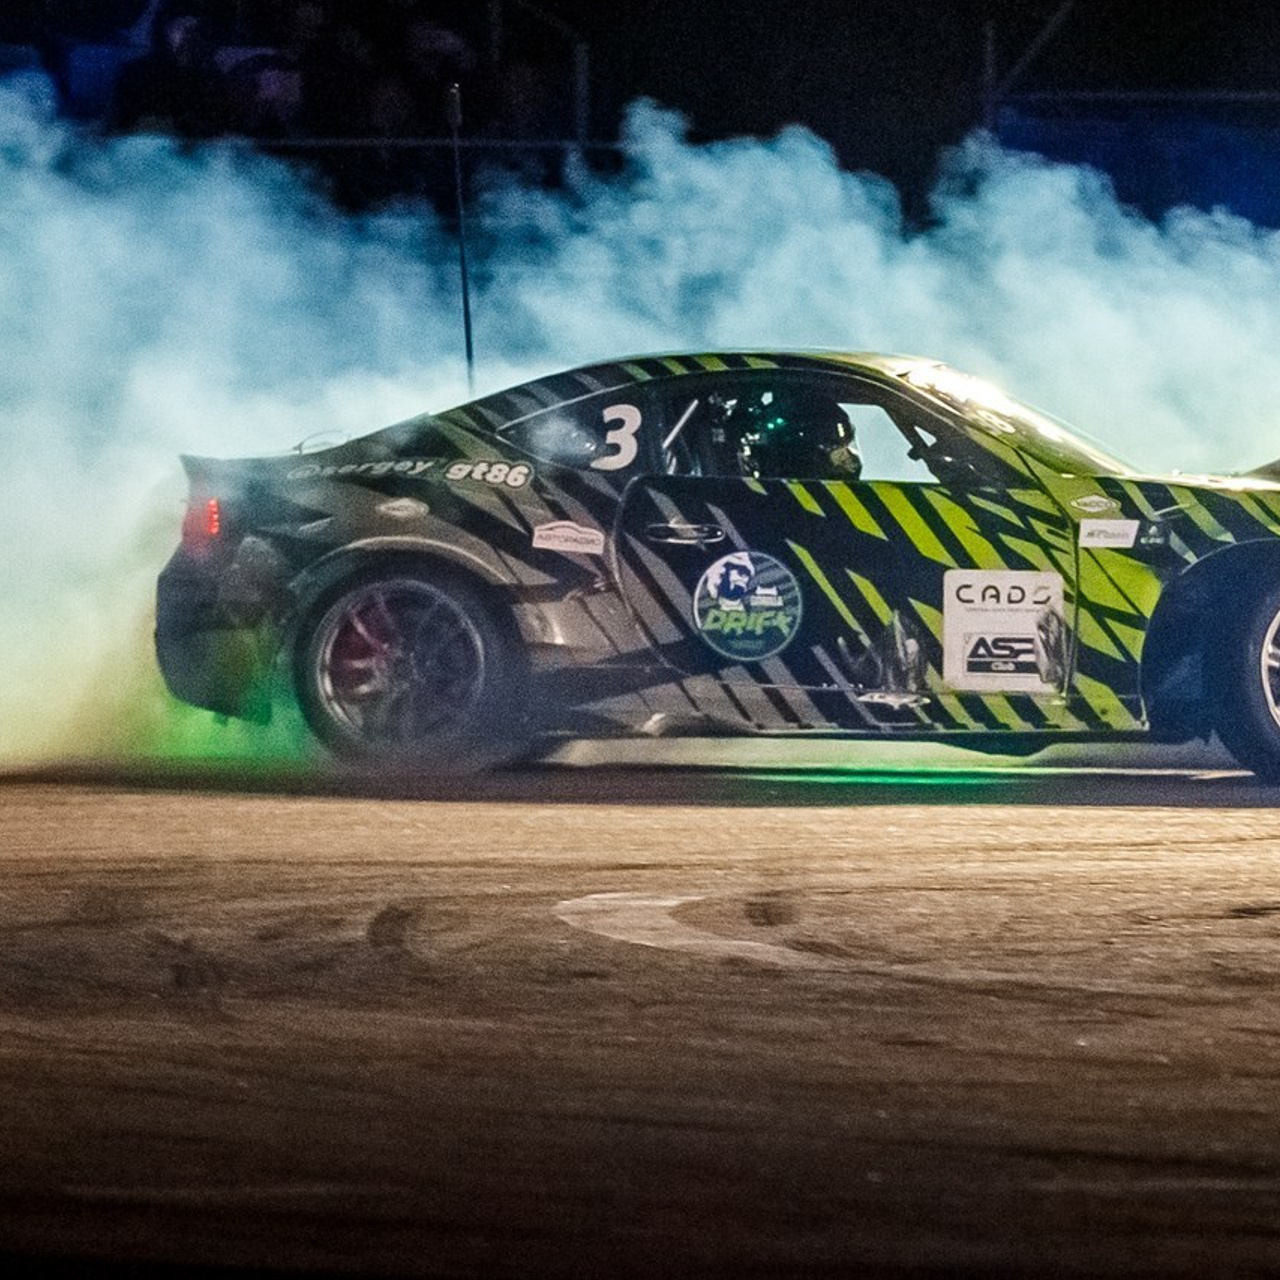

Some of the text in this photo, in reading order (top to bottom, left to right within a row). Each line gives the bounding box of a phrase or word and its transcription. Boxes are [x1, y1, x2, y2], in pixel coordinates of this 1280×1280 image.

[590, 404, 642, 471] 3
[446, 462, 530, 488] gt86
[956, 585, 1052, 605] CADS
[701, 608, 793, 637] DRIFT
